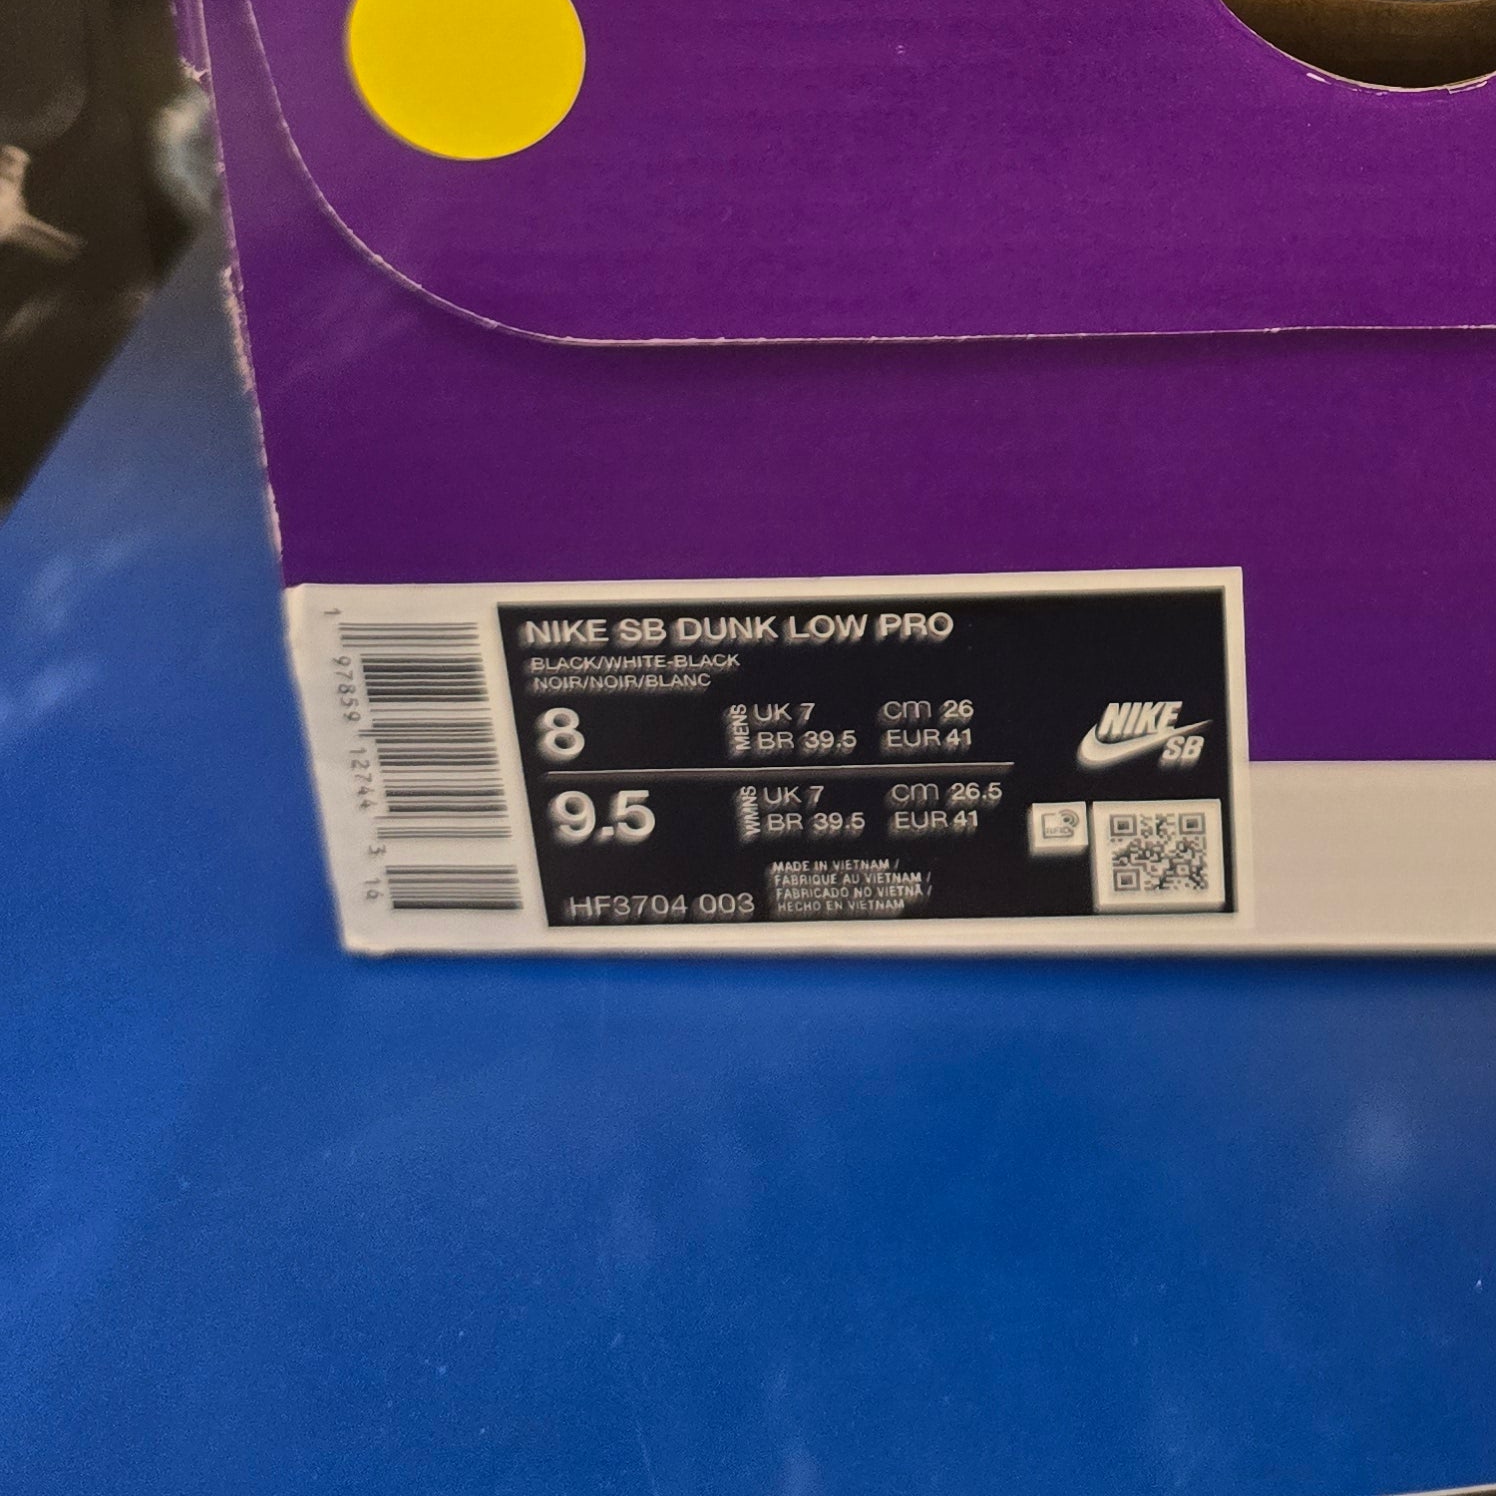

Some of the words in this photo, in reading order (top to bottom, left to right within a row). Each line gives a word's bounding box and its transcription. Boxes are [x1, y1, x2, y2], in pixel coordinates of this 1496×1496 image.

[524, 619, 609, 643] NIKE
[619, 617, 667, 642] SB
[676, 615, 778, 641] DUNK
[789, 614, 868, 639] LOW
[879, 611, 954, 637] PRO
[530, 654, 740, 671] BLACK/WHITE-BLACK
[533, 673, 711, 690] NOIR/NOIR/BLANC
[753, 703, 792, 721] UK
[800, 703, 815, 720] 7
[942, 699, 974, 719] 26
[1100, 701, 1183, 735] NIKE
[323, 607, 342, 617] 1
[333, 655, 361, 723] 97859
[349, 747, 375, 811] 12744
[368, 844, 387, 856] 3
[544, 707, 585, 756] 8
[729, 704, 751, 751] MENS
[887, 728, 941, 747] EUR
[946, 727, 972, 746] 41
[757, 731, 795, 749] BR
[803, 729, 857, 749] 39.5
[1162, 735, 1205, 761] SB
[764, 786, 802, 805] UK
[809, 785, 825, 803] 7
[950, 782, 1003, 801] 26.5
[555, 790, 656, 837] 9.5
[740, 785, 761, 836] WMNS
[894, 811, 949, 829] EUR
[953, 809, 979, 827] 41
[767, 812, 804, 831] BR
[813, 811, 866, 830] 39.5
[772, 860, 811, 872] MADE
[814, 860, 828, 871] IN
[832, 858, 890, 870] VIETNAM
[774, 873, 837, 886] FABRIQUE
[842, 873, 860, 884] AU
[865, 872, 922, 883] VIETNAM
[776, 886, 850, 900] FABRICADO
[854, 886, 872, 898] NO
[569, 894, 688, 917] HF3704
[699, 892, 755, 915] 003
[778, 900, 822, 912] HECHO
[826, 900, 844, 911] EN
[849, 898, 905, 910] VIETNAM
